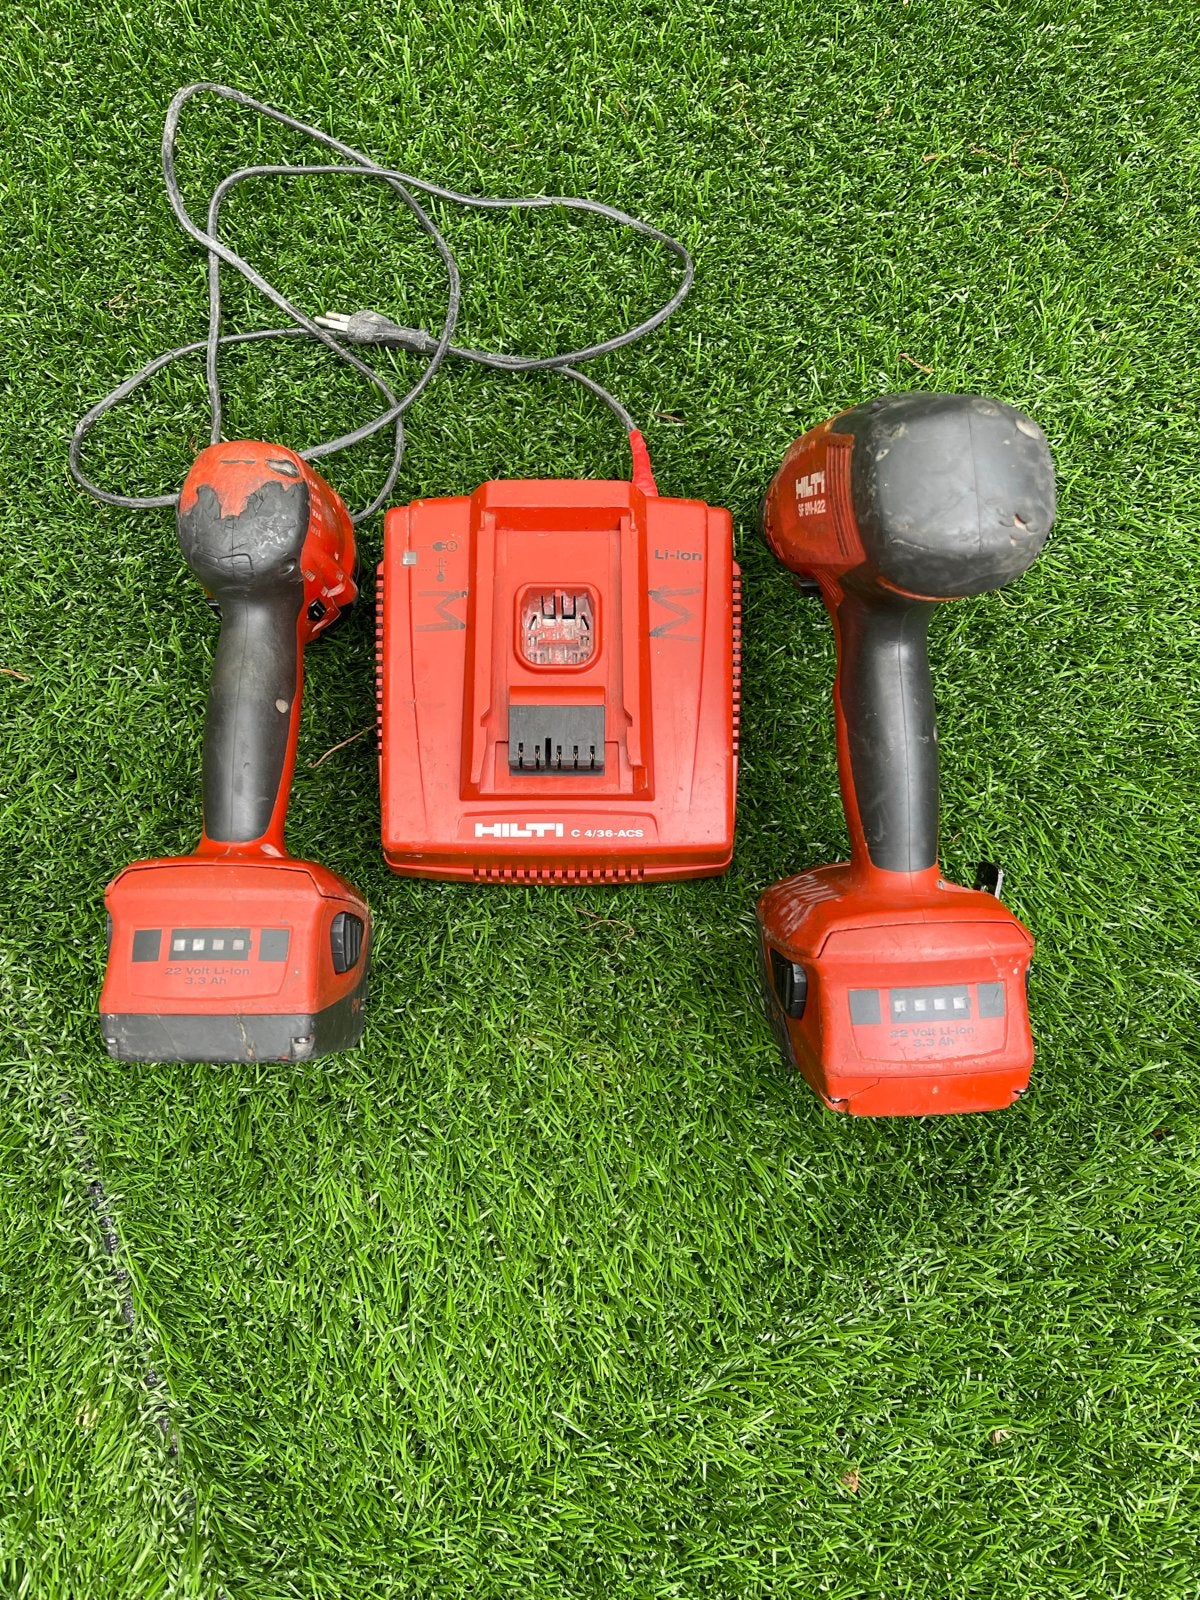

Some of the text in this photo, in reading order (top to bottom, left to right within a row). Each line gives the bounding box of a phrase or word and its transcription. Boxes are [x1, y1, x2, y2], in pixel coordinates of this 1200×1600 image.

[795, 470, 825, 500] HILTI
[654, 549, 702, 562] Li-Ion
[474, 823, 645, 839] HILTI C 4/36-ACS
[165, 967, 250, 976] 22 Volt Li-Ion
[184, 976, 227, 986] 3.3 Ah
[911, 1027, 936, 1037] Volt
[939, 1025, 975, 1036] Li-Ion
[912, 1036, 955, 1048] 3.3 Ah
